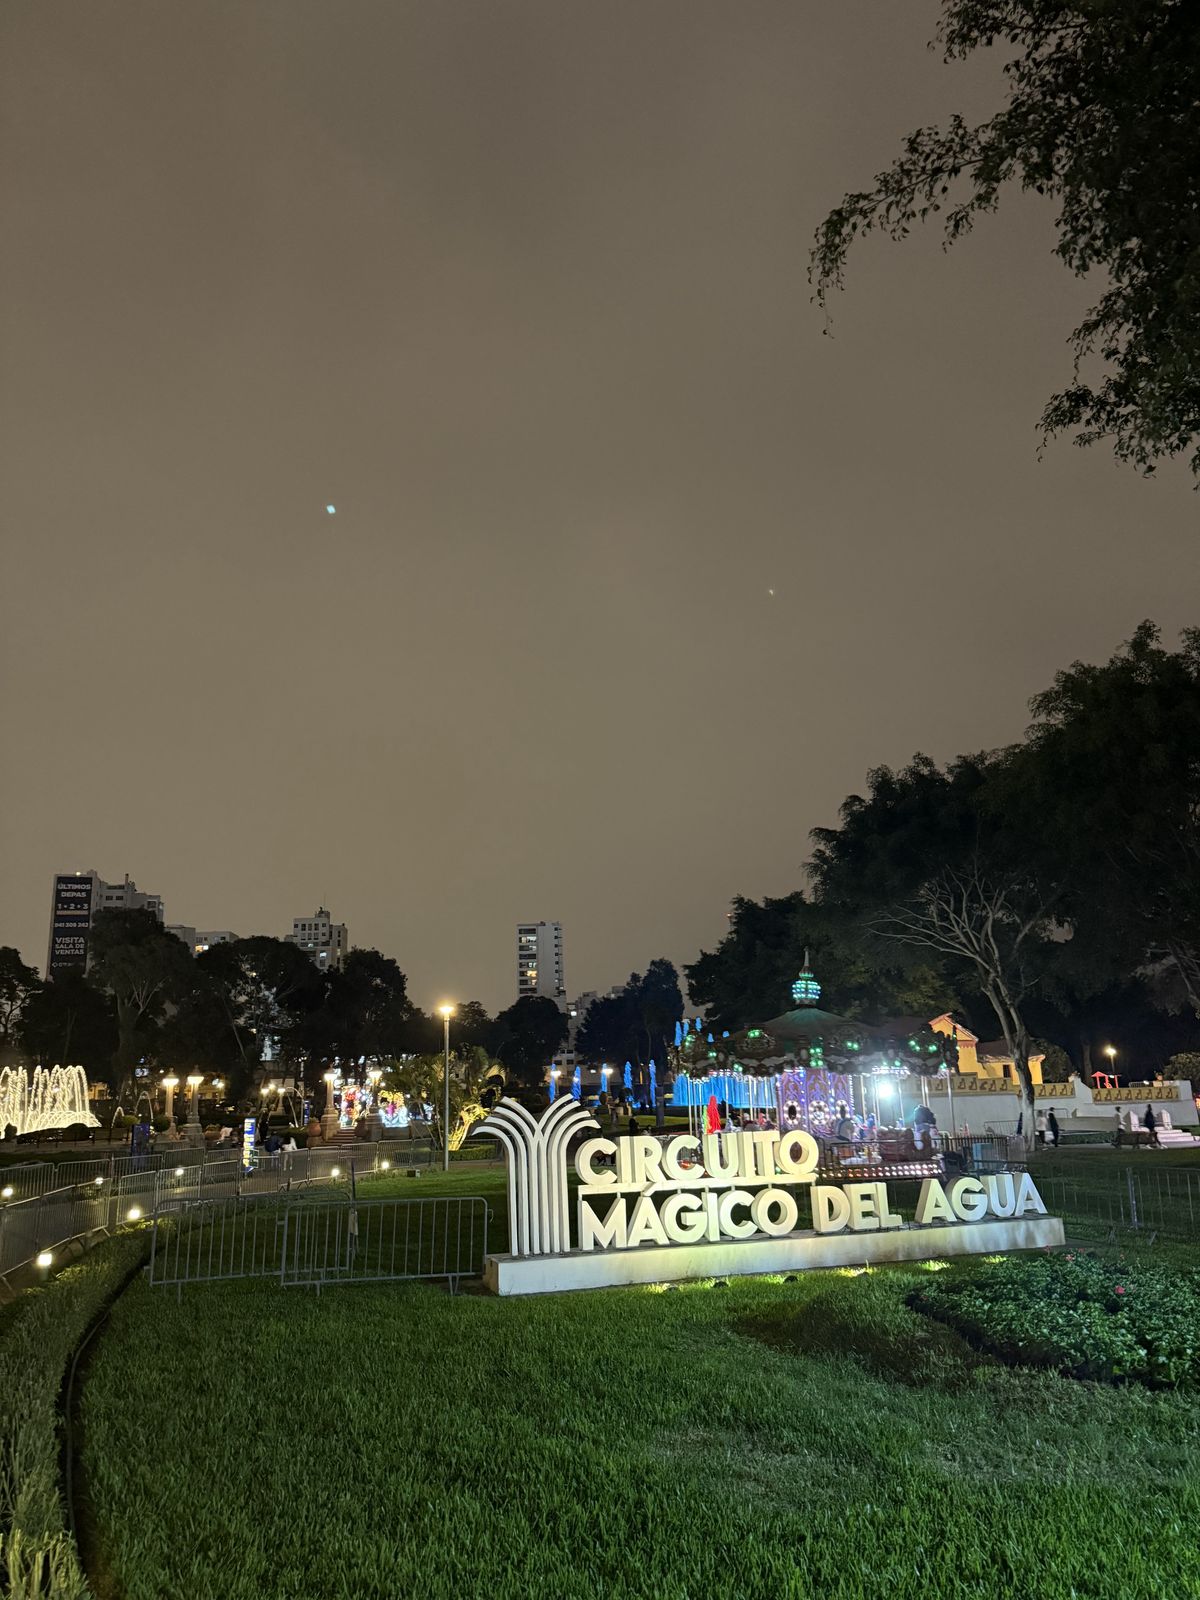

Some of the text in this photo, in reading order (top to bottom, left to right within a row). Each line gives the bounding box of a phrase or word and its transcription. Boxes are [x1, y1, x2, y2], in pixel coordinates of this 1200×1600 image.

[575, 1130, 819, 1186] CIRCUITO
[578, 1172, 1048, 1250] MÁGICO DEL AGUA
